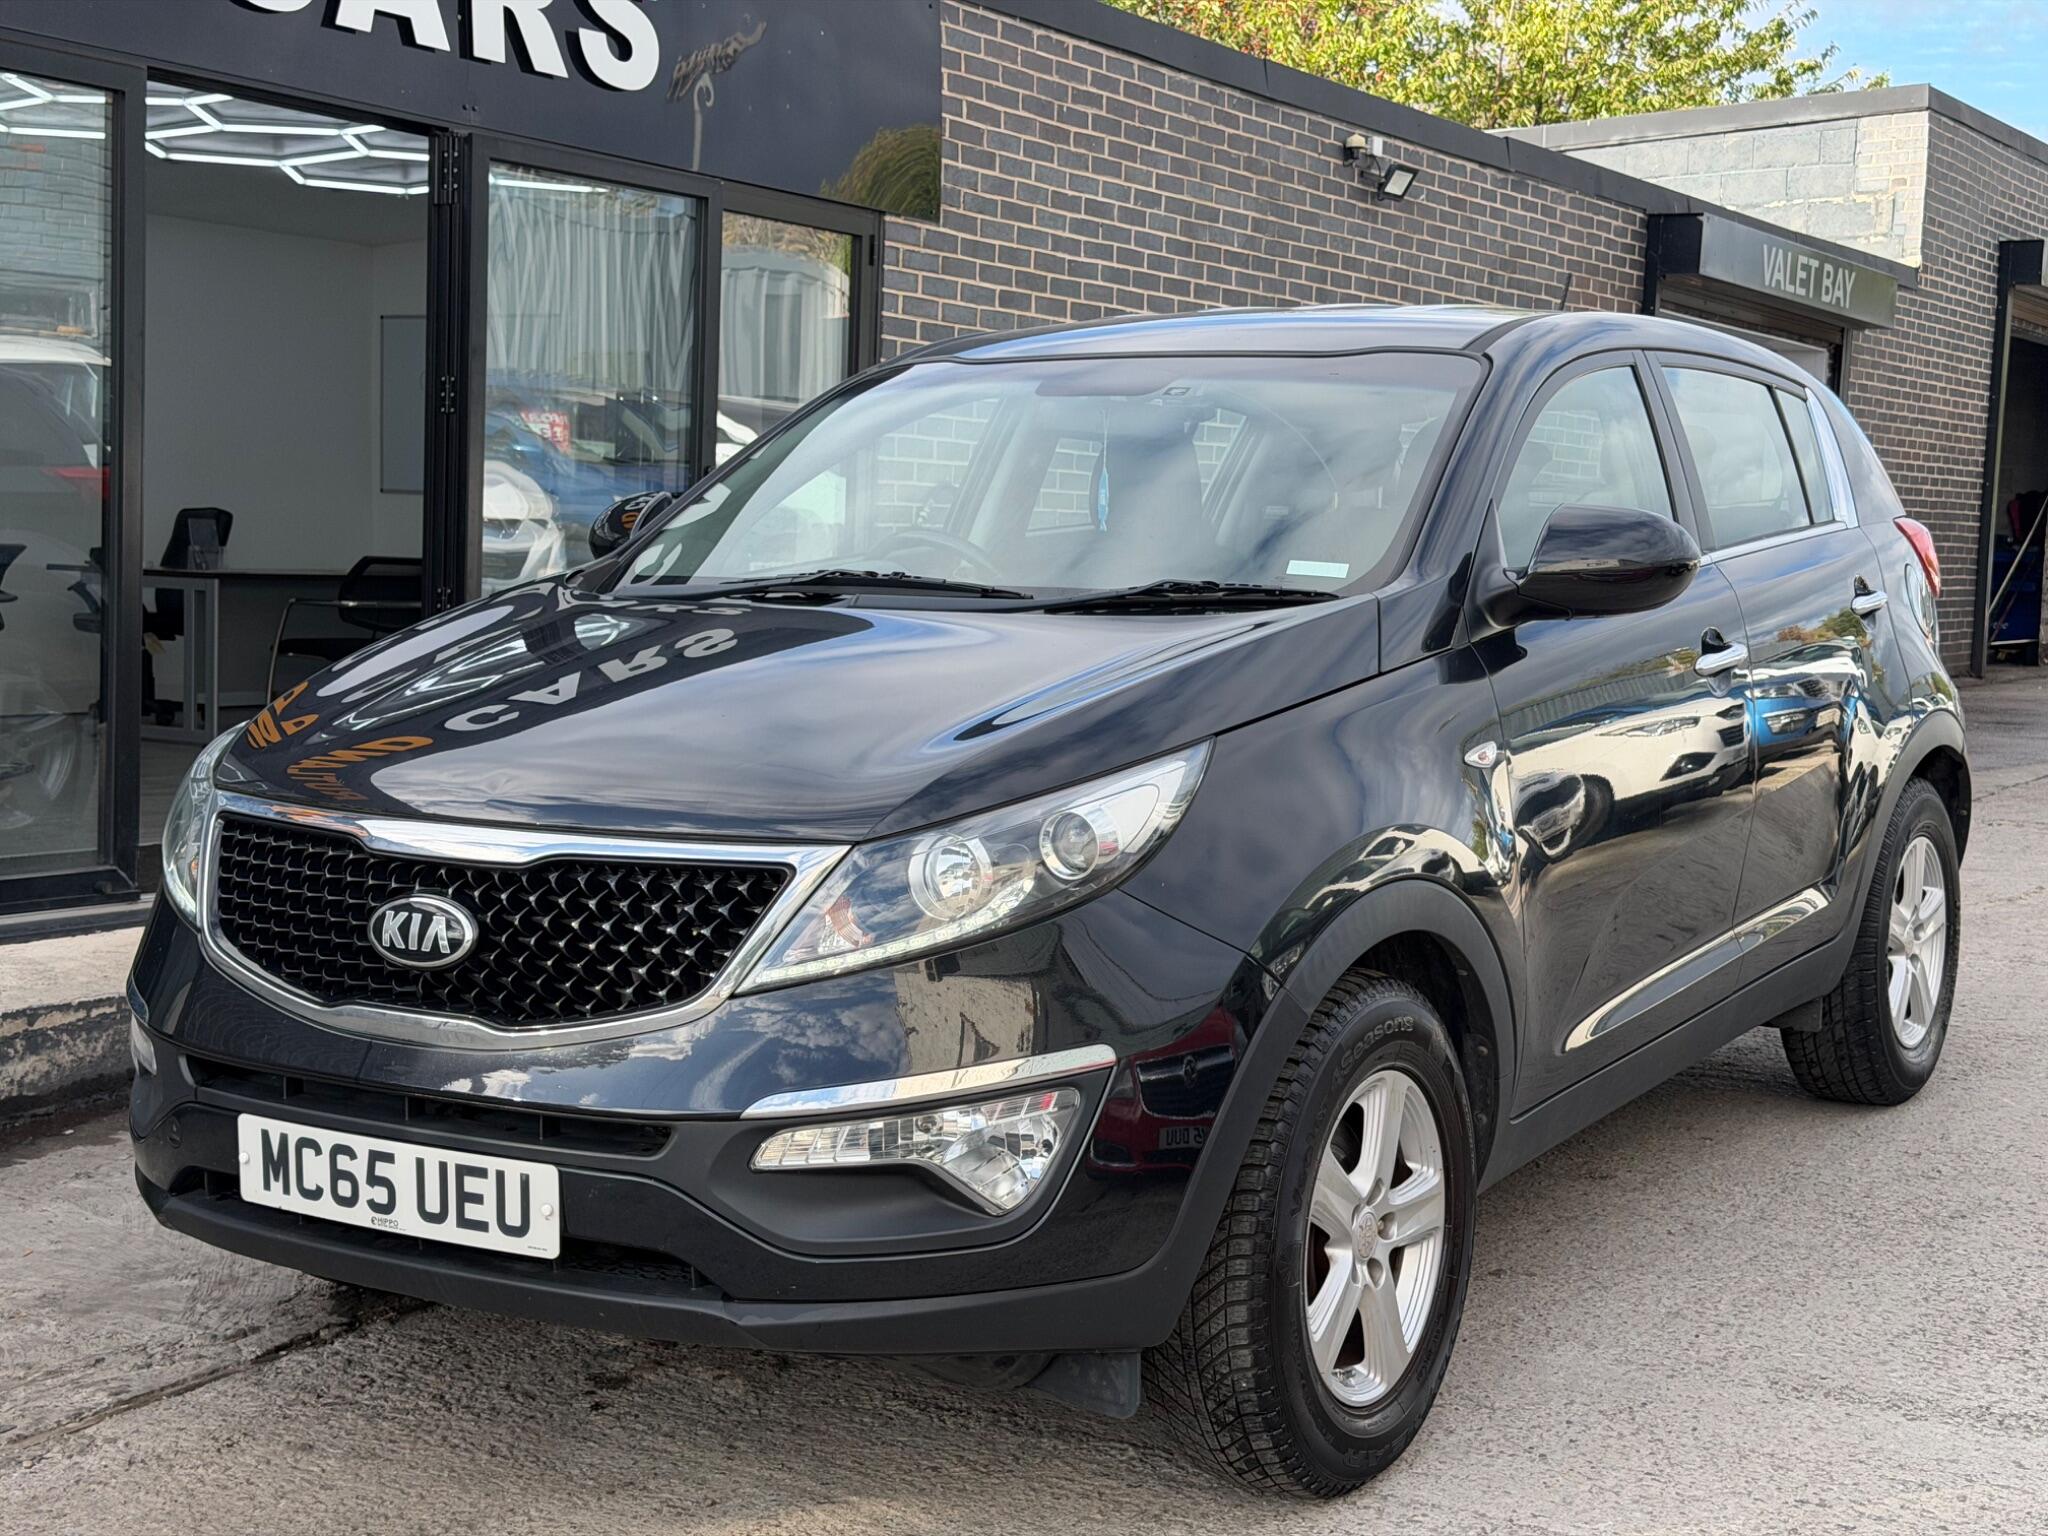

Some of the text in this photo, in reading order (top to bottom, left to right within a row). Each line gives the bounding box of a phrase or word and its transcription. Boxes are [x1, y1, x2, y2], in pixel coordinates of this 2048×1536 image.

[1763, 244, 1856, 309] VALET BAY
[382, 910, 451, 954] KIA
[260, 1128, 531, 1239] MC65 UEU
